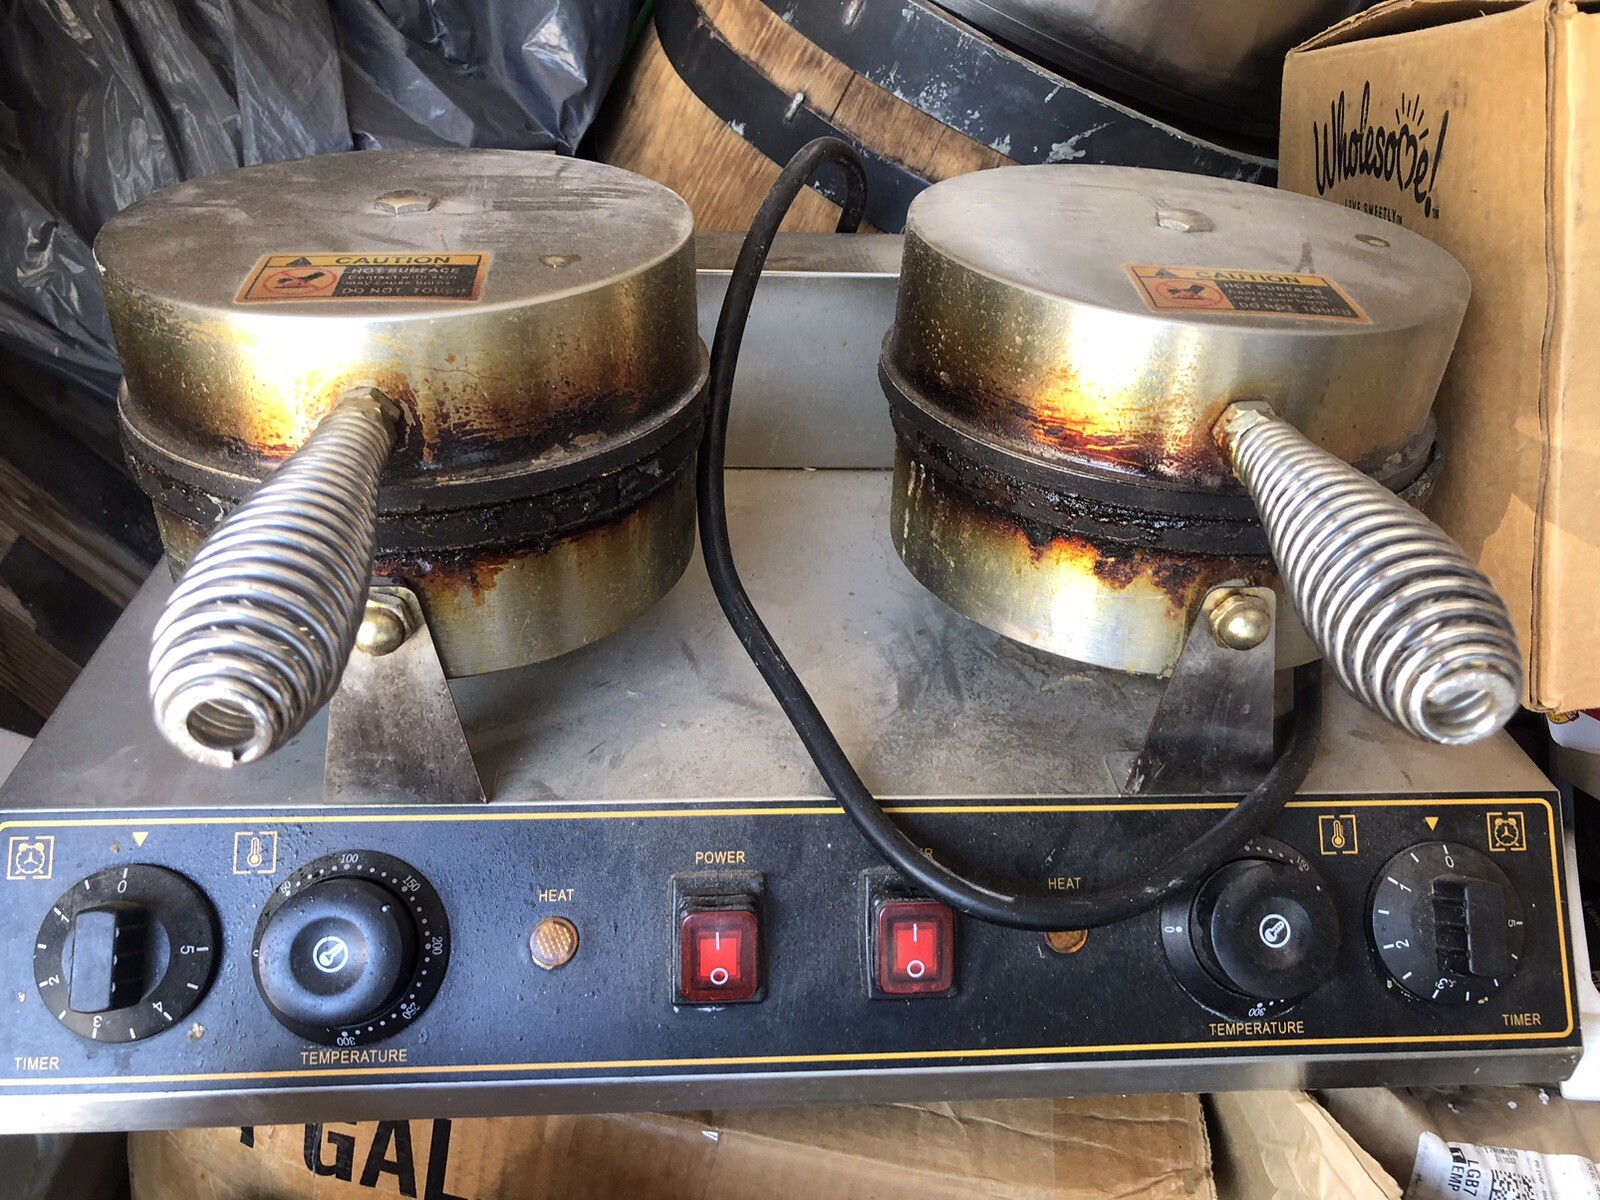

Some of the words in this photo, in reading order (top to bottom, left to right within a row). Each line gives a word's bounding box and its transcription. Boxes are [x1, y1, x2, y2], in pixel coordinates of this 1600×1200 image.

[335, 256, 451, 265] CAUTION
[1195, 270, 1301, 284] CAUTION
[340, 853, 360, 865] 100
[694, 851, 746, 865] POWER
[117, 879, 128, 894] 0
[279, 881, 292, 895] 50
[402, 874, 421, 892] 150
[1047, 876, 1082, 891] HEAT
[538, 888, 575, 903] HEAT
[180, 944, 195, 955] 5
[431, 936, 443, 955] 200
[1395, 938, 1410, 951] 2
[48, 974, 60, 987] 2
[152, 1001, 167, 1015] 4
[401, 1001, 420, 1020] 250
[1248, 1006, 1266, 1017] 300
[92, 1015, 103, 1029] 3
[1502, 1013, 1542, 1027] TIMER
[1209, 1020, 1305, 1036] TEMPERATURE
[336, 1036, 356, 1047] 300
[14, 1056, 60, 1071] TIMER
[300, 1048, 408, 1066] TEMPERATURE
[304, 1118, 468, 1200] GAL
